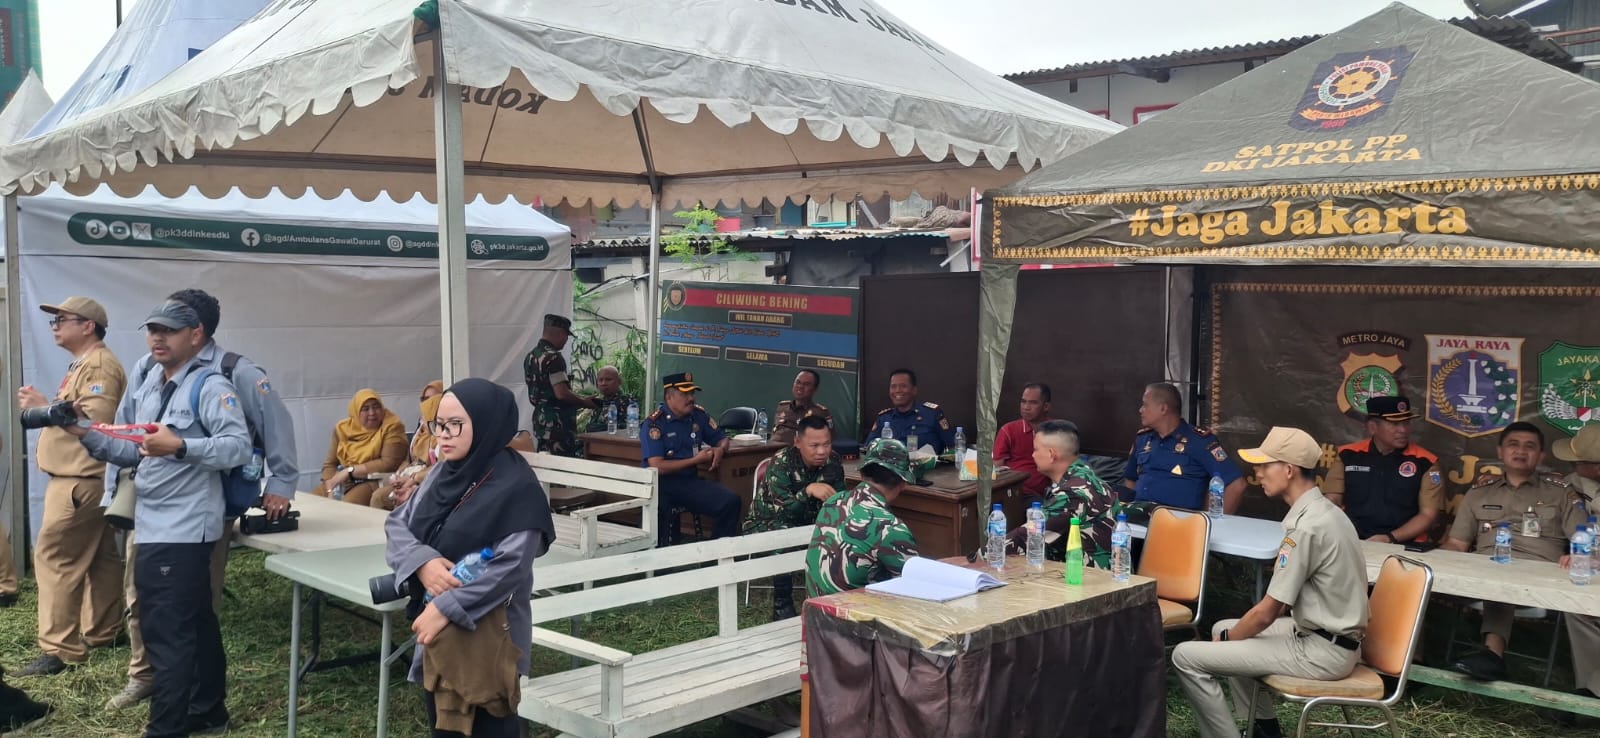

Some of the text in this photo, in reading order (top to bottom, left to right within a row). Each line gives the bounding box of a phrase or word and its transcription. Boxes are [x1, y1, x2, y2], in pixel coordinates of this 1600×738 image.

[1235, 134, 1407, 158] SATPOL PP
[1201, 148, 1422, 172] DKI JAKARTA
[1128, 200, 1467, 244] #Jaga Jakarta
[716, 293, 808, 310] CILIWUNG BENING
[1342, 333, 1405, 348] METRO JAYA
[1437, 338, 1511, 350] JAYA RAYA
